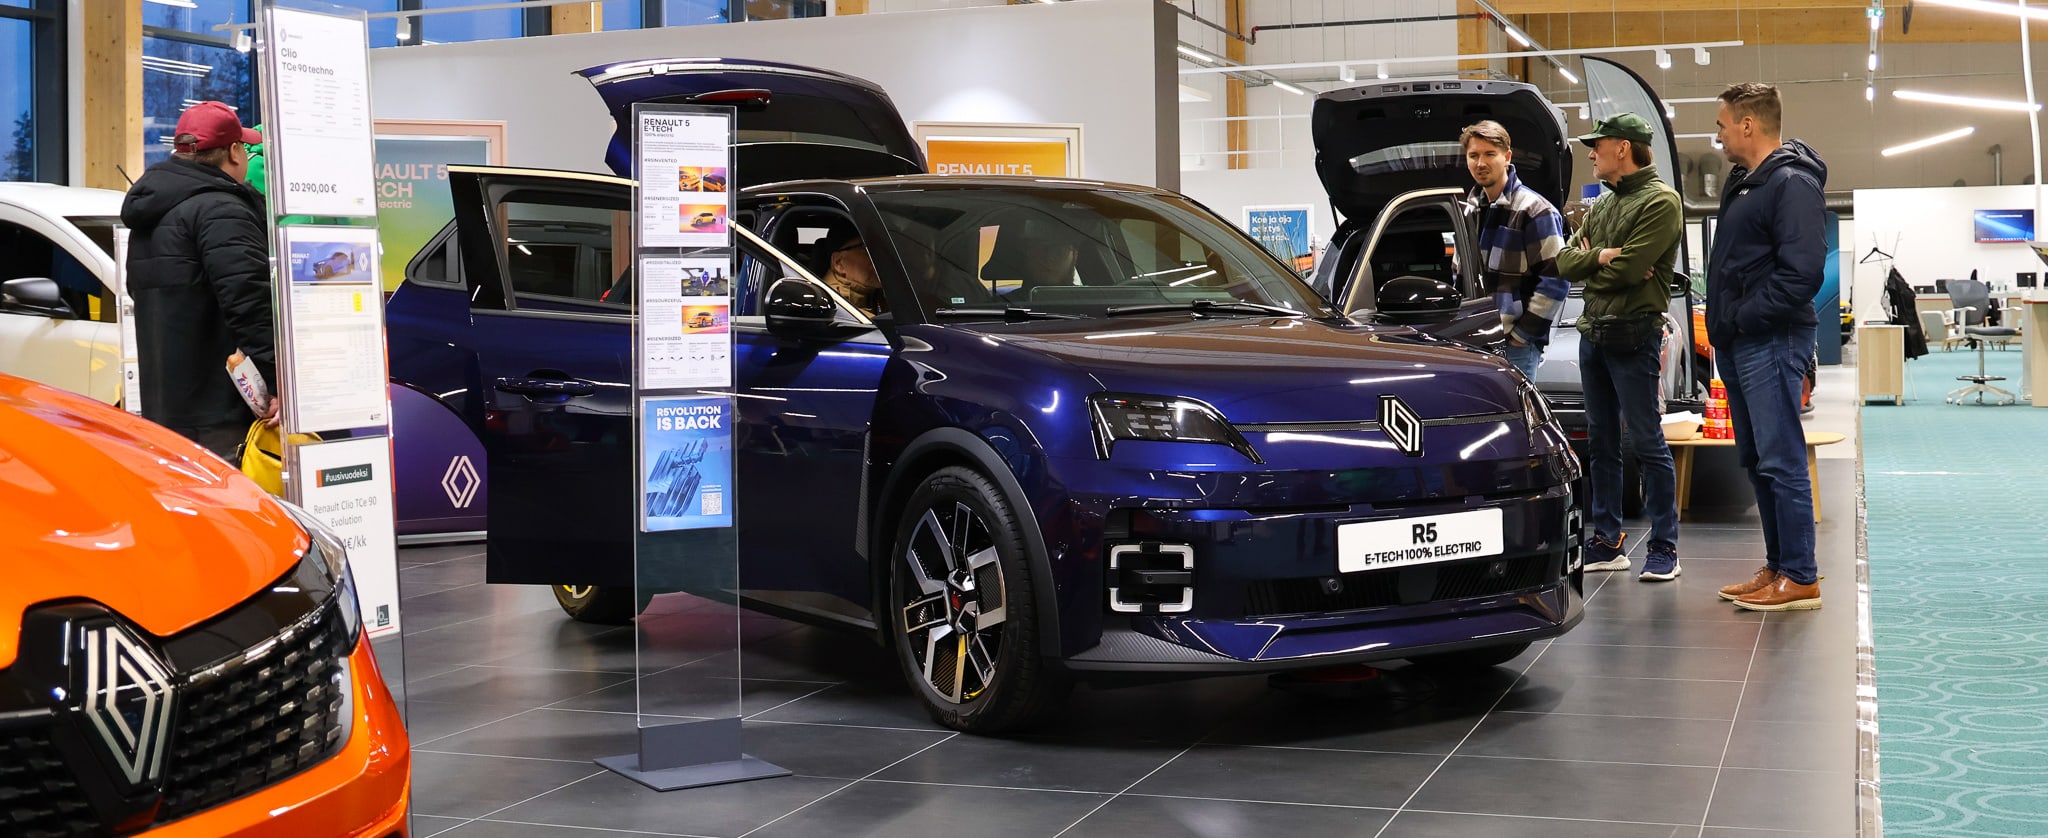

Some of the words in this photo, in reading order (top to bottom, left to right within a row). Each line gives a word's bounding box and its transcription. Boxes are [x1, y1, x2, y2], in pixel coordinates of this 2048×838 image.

[281, 48, 297, 58] Clio
[282, 62, 296, 71] TCe
[298, 64, 307, 72] 90
[308, 65, 334, 75] techno
[644, 118, 683, 126] RENAULT
[437, 163, 449, 180] 5
[290, 182, 300, 192] 20
[302, 183, 330, 194] 290,00
[331, 184, 337, 193] €
[1268, 215, 1277, 224] ja
[1278, 215, 1292, 224] aja
[656, 406, 721, 417] R5VOLUTION
[656, 416, 672, 431] IS
[675, 415, 721, 430] BACK
[325, 468, 368, 482] #uusivuodeksi
[314, 502, 339, 514] Renault
[341, 500, 353, 510] Clio
[355, 498, 367, 508] TCe
[368, 496, 377, 506] 90
[331, 514, 362, 527] Evolution
[1412, 522, 1438, 544] R5
[1365, 550, 1404, 565] E-TECH
[1406, 547, 1433, 560] 100%
[1435, 541, 1482, 557] ELECTRIC
